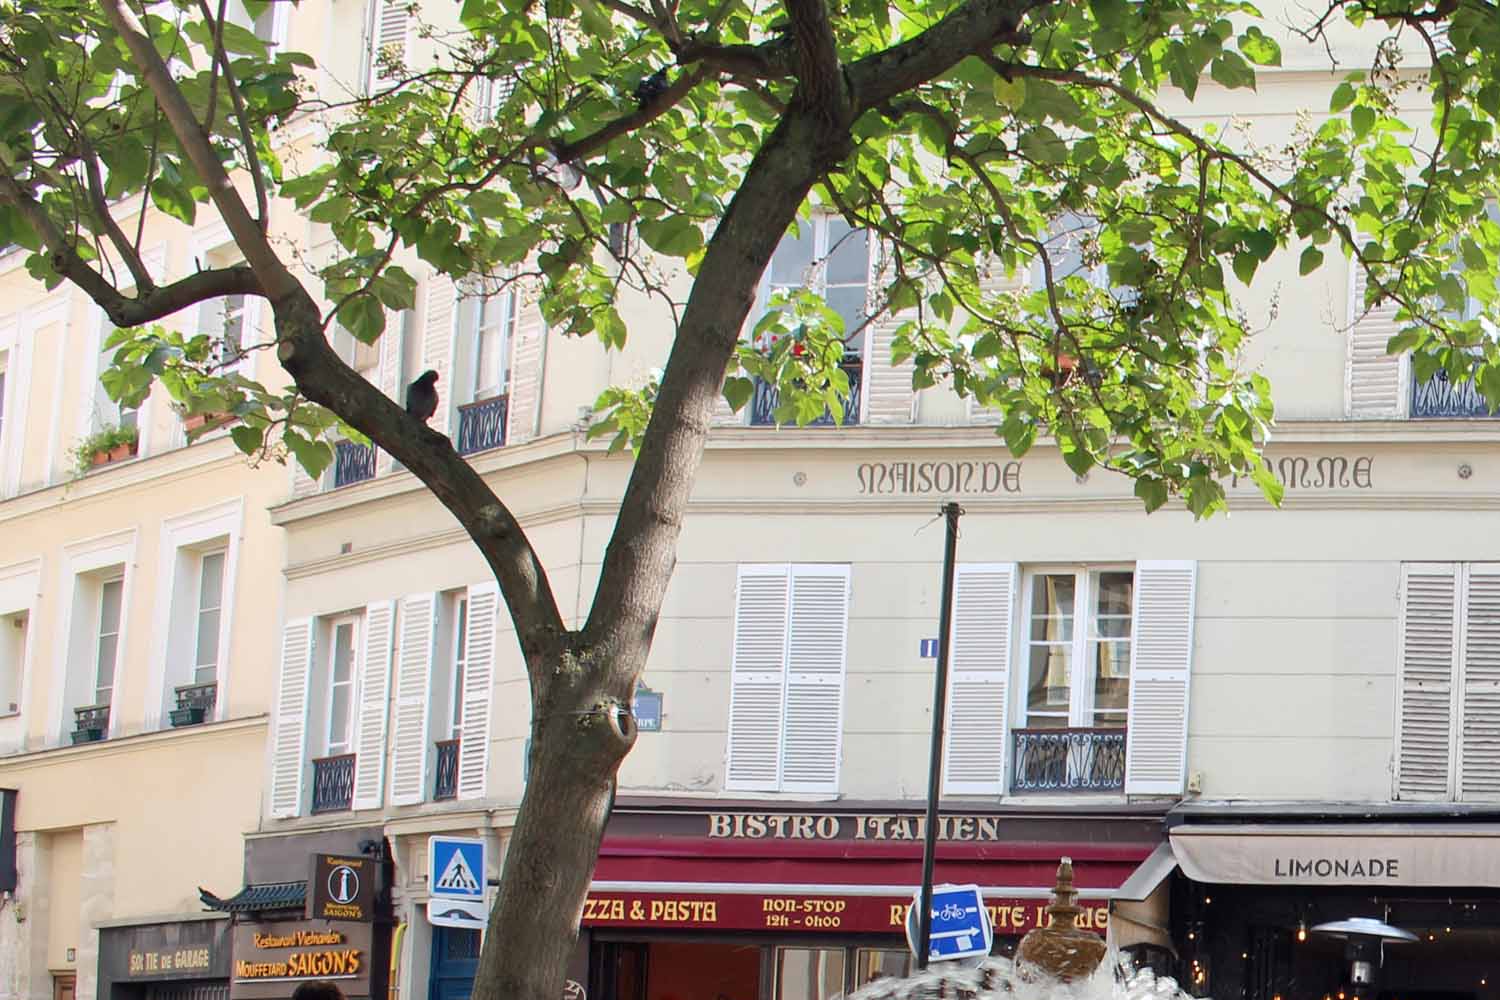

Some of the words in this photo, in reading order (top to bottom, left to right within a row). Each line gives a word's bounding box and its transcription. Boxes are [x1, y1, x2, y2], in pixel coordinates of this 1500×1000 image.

[708, 815, 840, 839] BISTRO
[1274, 858, 1400, 878] LIMONADE
[583, 899, 625, 920] ZZA
[629, 900, 646, 920] &
[651, 900, 718, 922] PASTA
[763, 898, 846, 913] NON-STOP
[161, 954, 173, 969] DE
[175, 948, 209, 969] GARAGE
[287, 949, 360, 977] SAIGON'S
